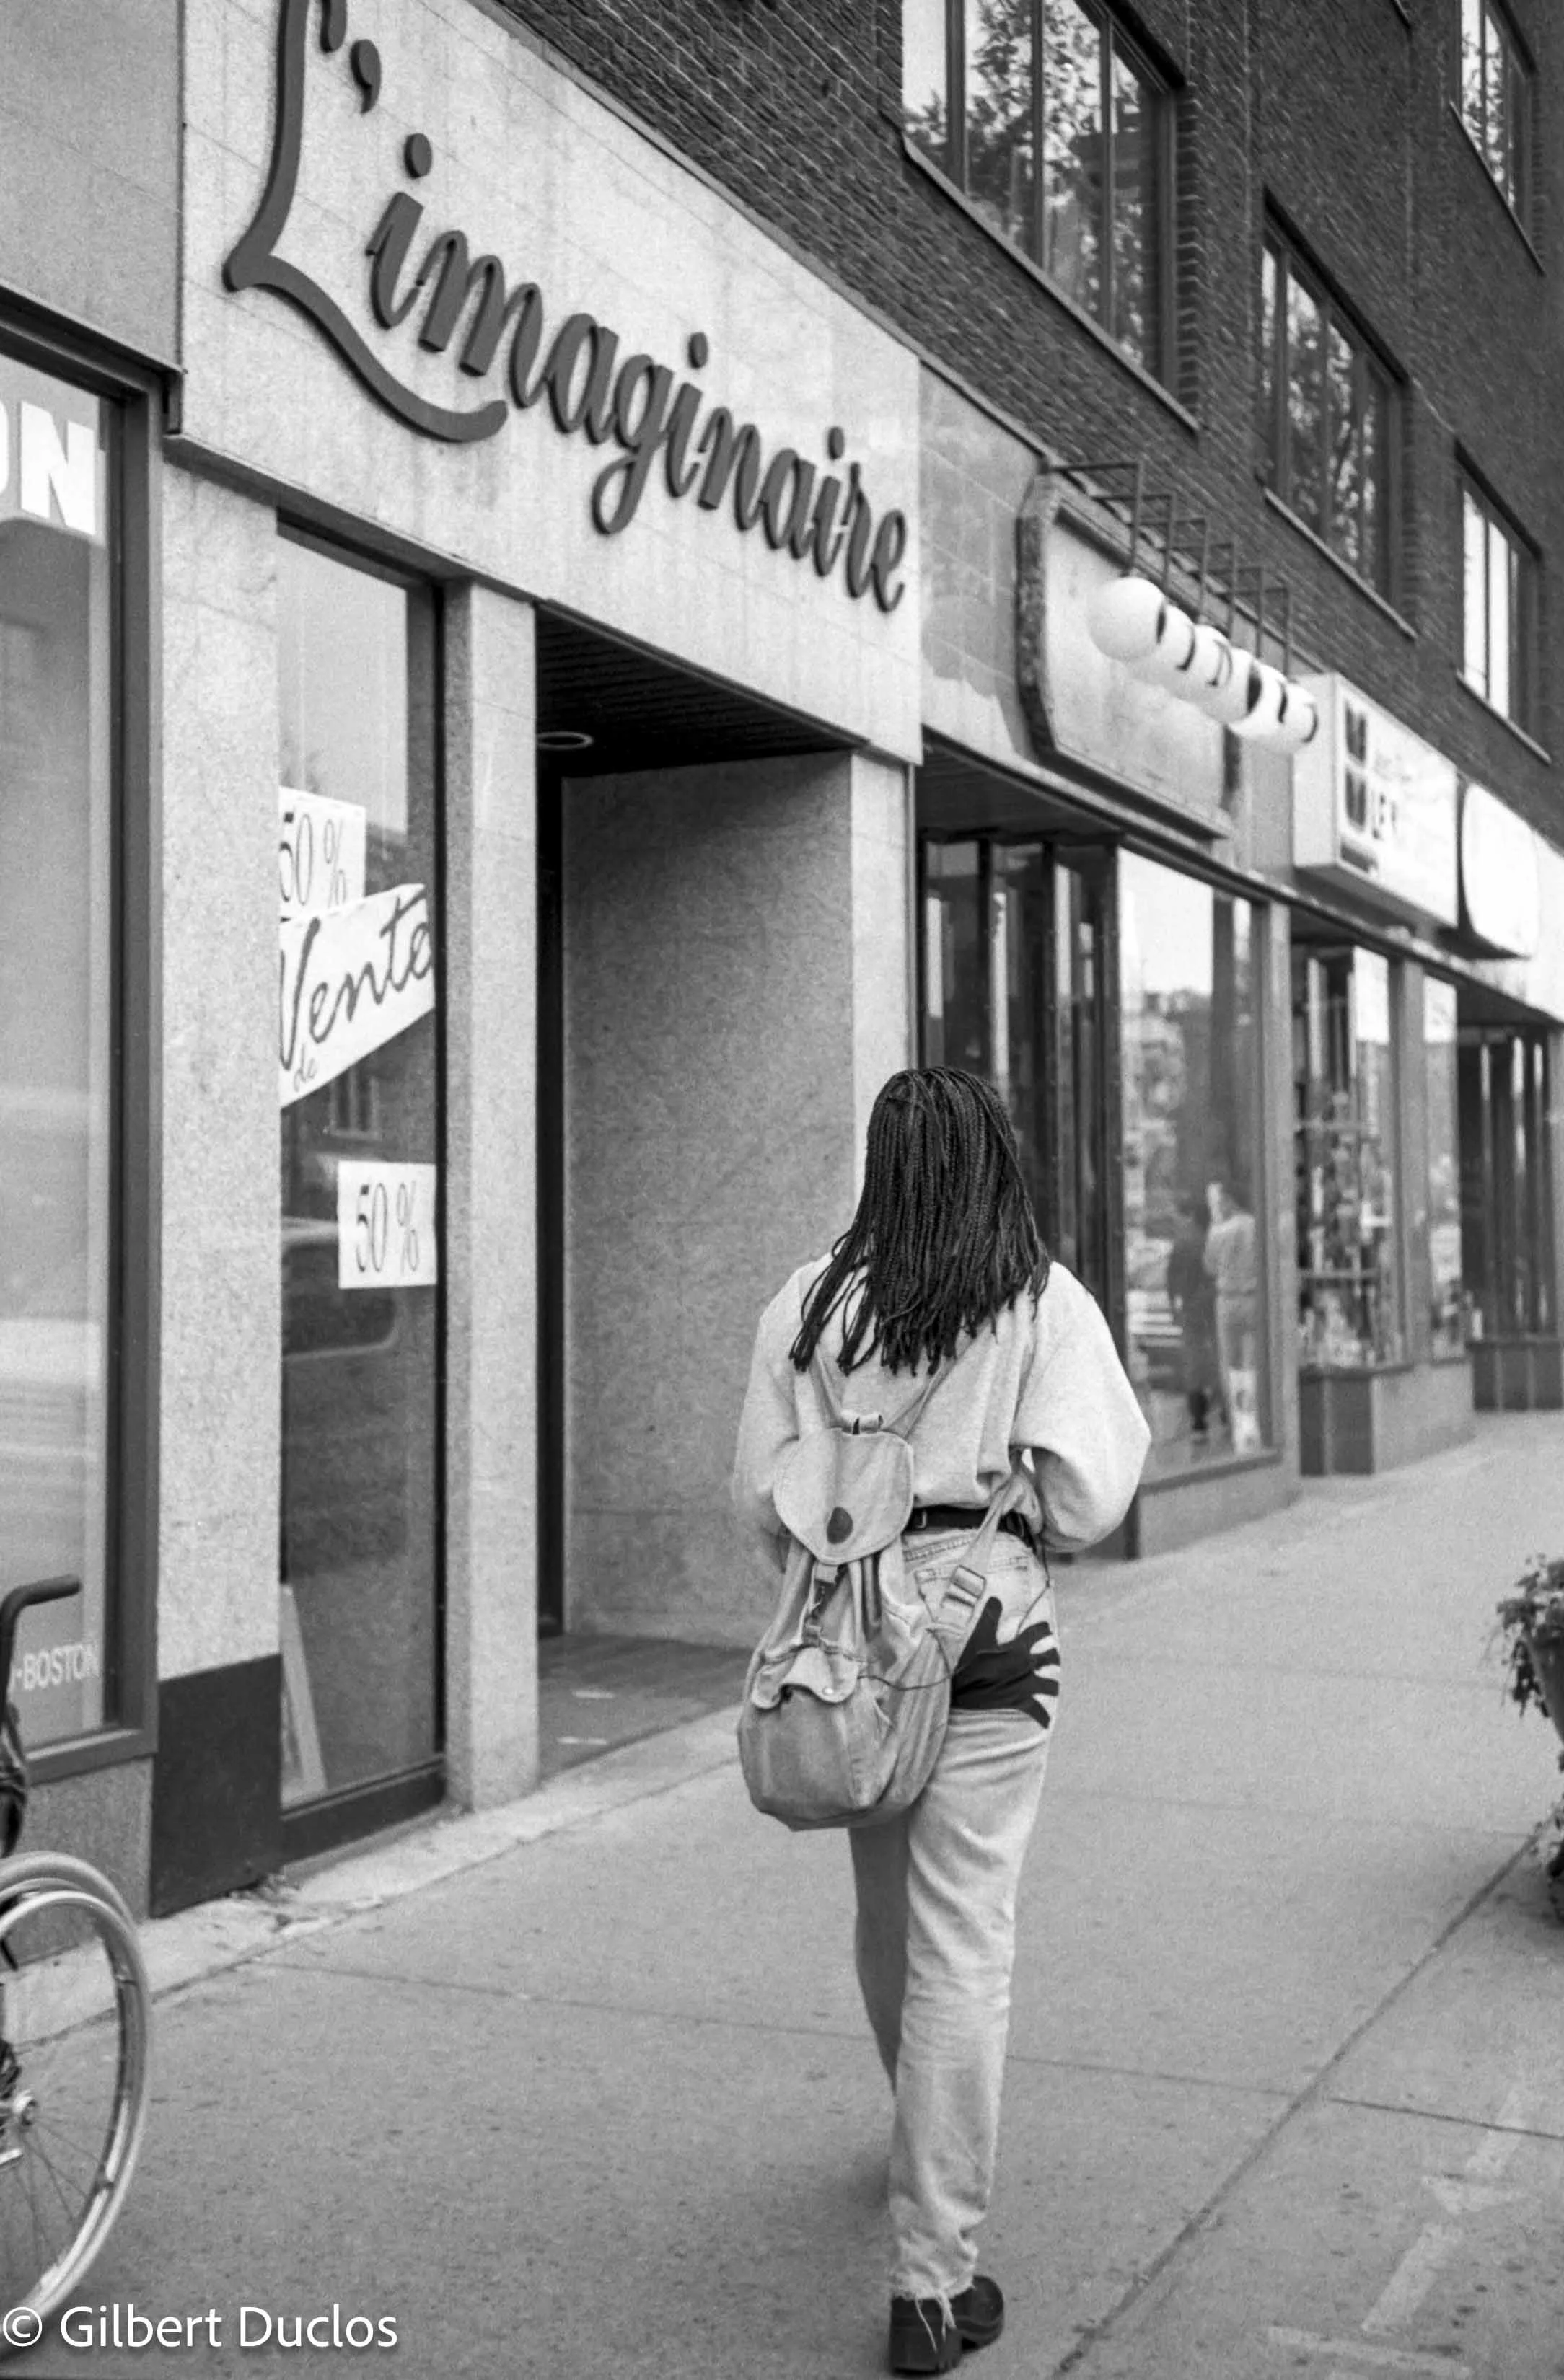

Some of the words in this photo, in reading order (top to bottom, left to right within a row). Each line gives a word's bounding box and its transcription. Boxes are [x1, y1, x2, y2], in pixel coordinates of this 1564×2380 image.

[223, 0, 907, 613] L'imaginaire
[0, 400, 95, 536] N
[279, 890, 431, 1071] Vente
